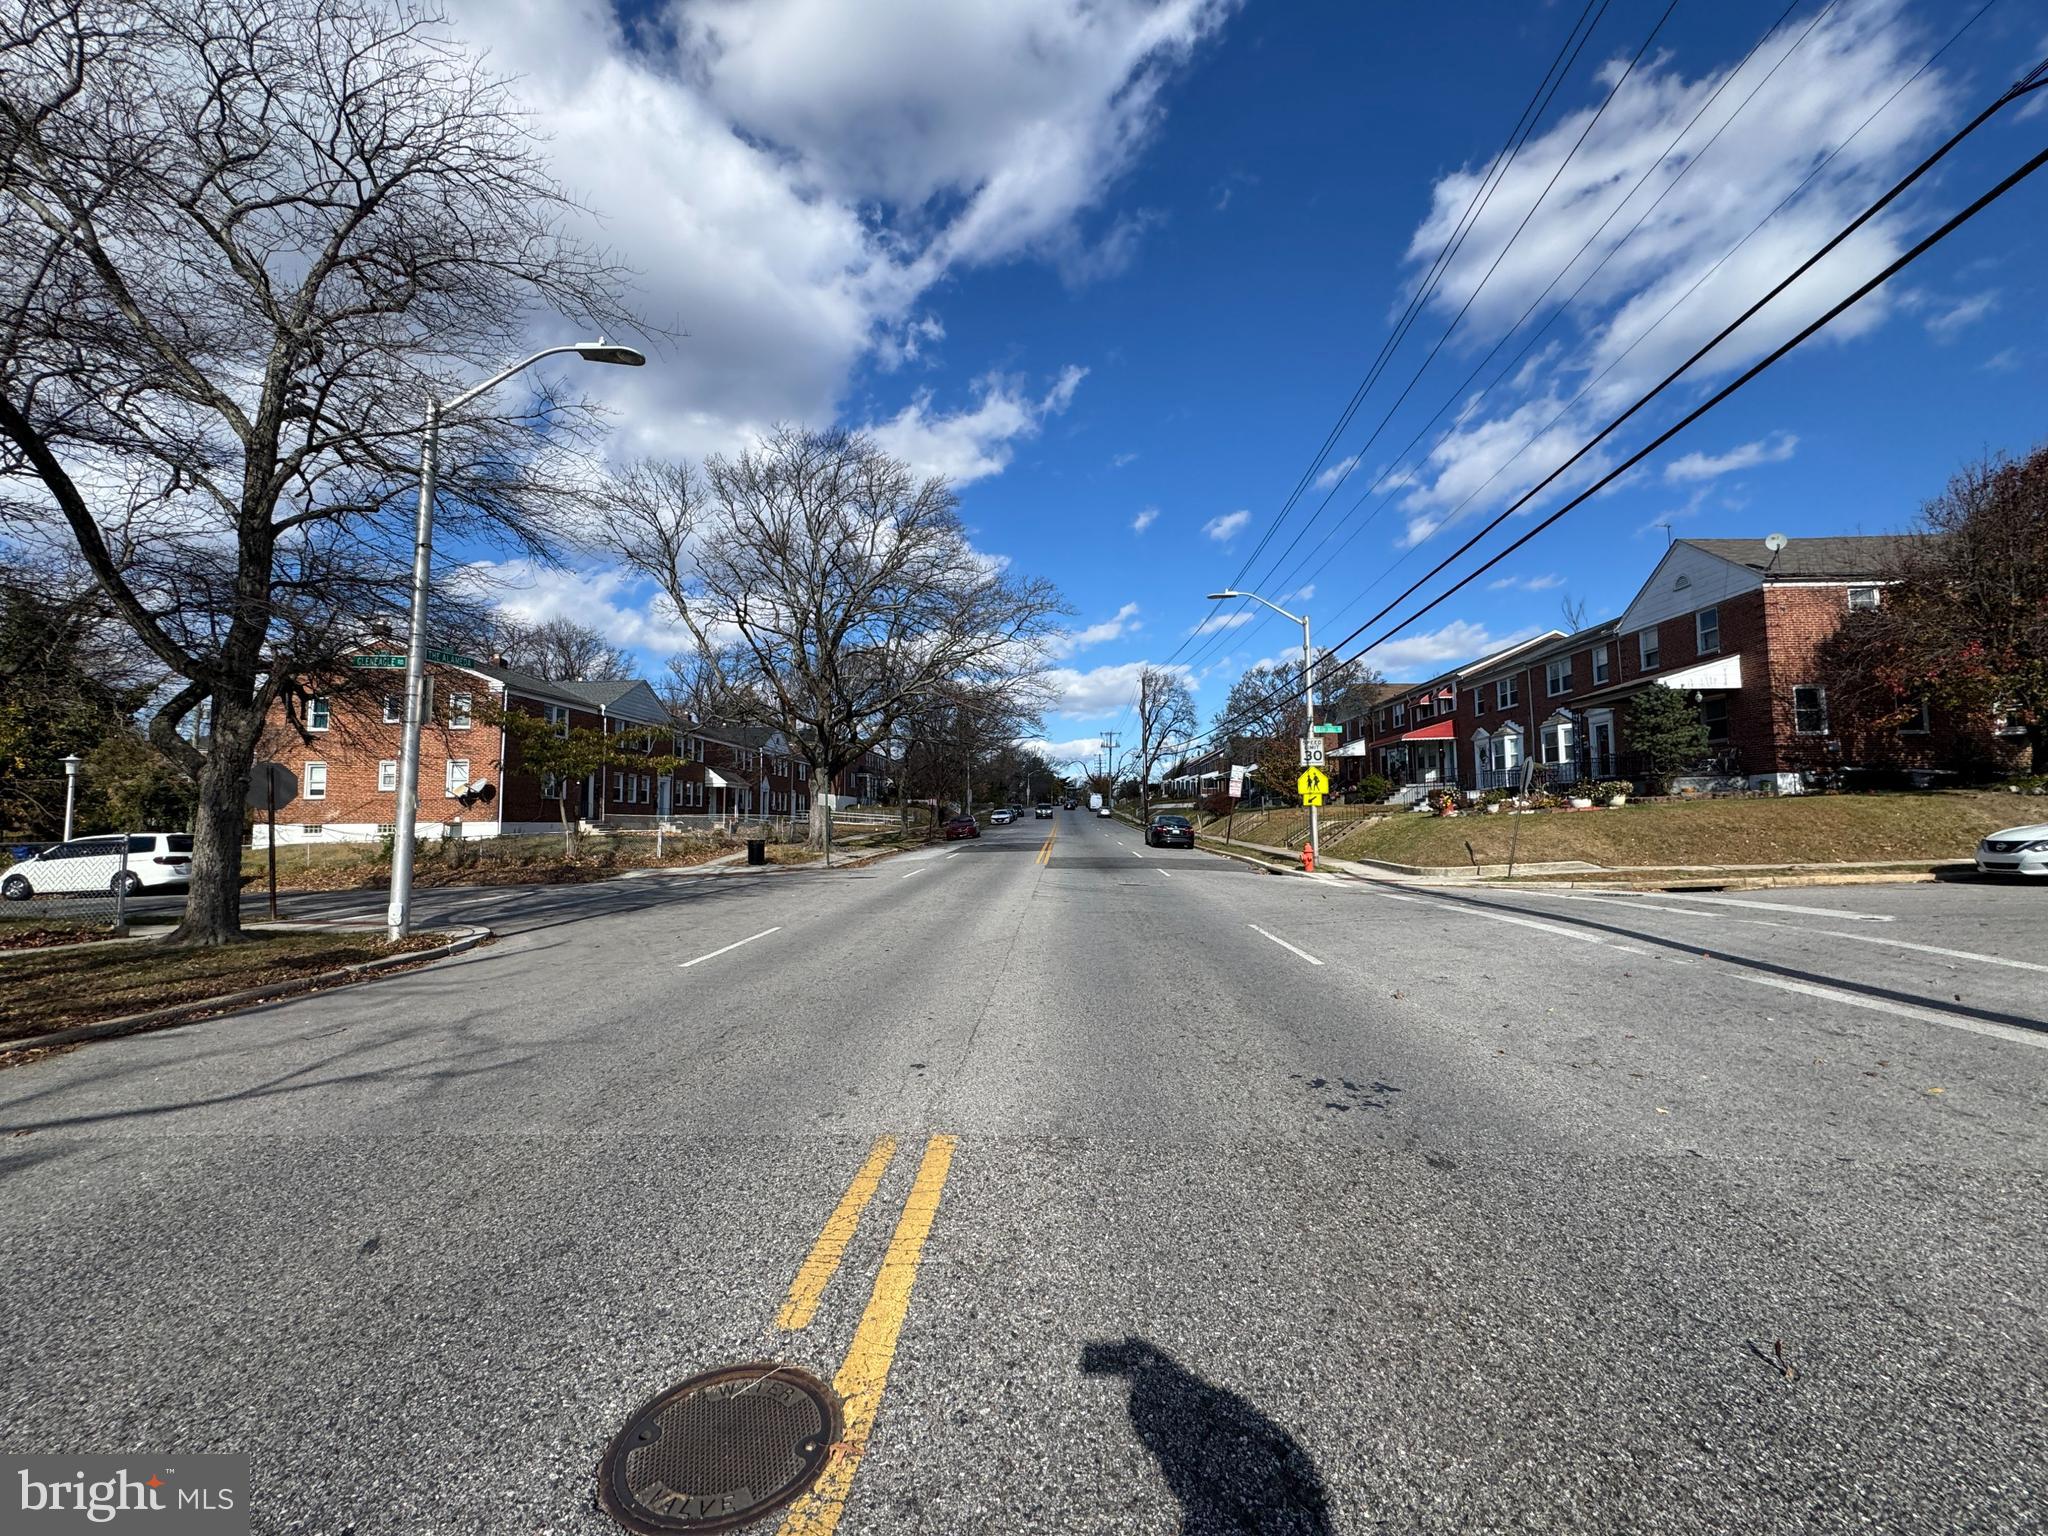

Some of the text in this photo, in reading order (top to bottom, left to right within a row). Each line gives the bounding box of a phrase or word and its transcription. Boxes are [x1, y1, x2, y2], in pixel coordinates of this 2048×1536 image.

[357, 657, 396, 667] GLENEAGLE
[428, 650, 441, 662] THE
[443, 654, 473, 667] ALAMEDA
[1304, 750, 1322, 761] 30
[718, 1380, 796, 1404] WATER
[649, 1487, 736, 1518] VALVE
